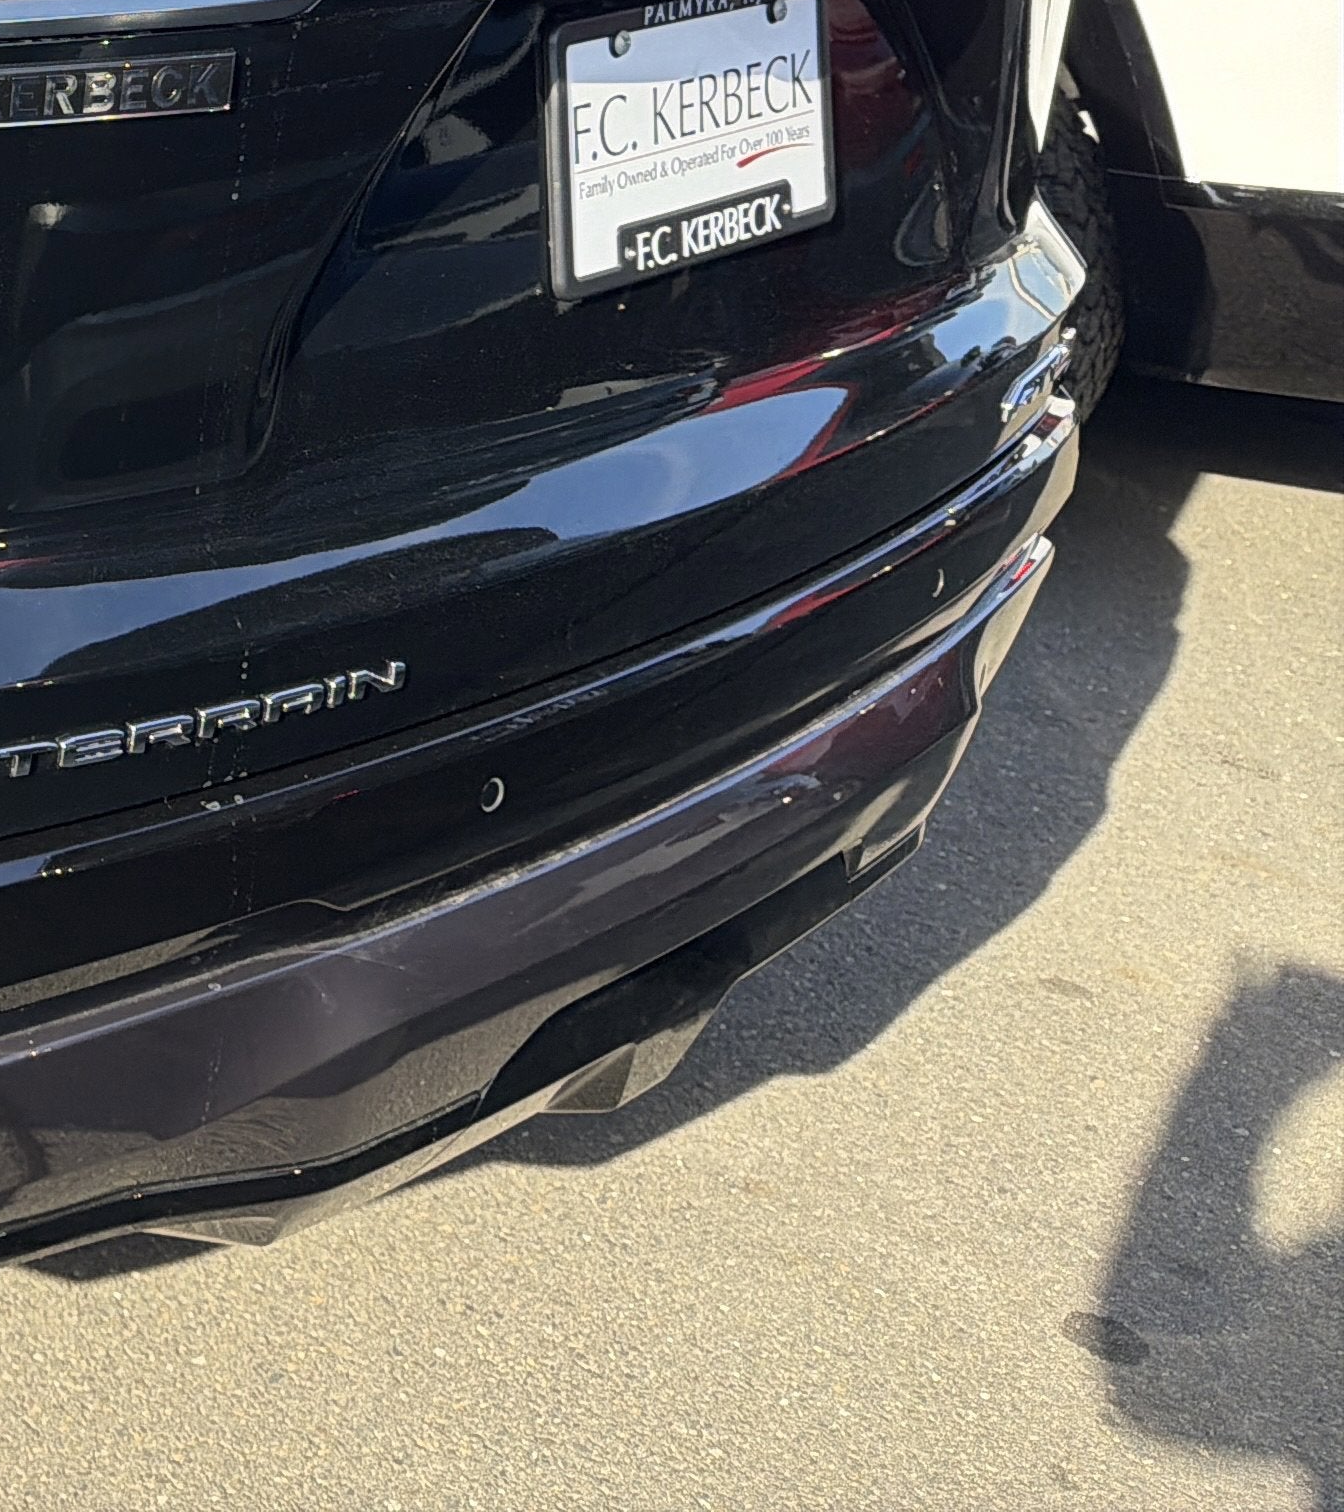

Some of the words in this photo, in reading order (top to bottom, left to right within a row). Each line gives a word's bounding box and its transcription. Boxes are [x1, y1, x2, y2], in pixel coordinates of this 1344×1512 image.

[574, 94, 638, 165] F.C.
[652, 48, 812, 145] KERBECK
[578, 175, 615, 200] Family
[616, 162, 658, 190] Owned
[661, 162, 669, 178] &
[670, 145, 720, 177] Operated
[720, 143, 737, 162] For
[738, 136, 763, 156] Over
[765, 129, 784, 148] 100
[784, 124, 810, 143] Years
[636, 225, 679, 271] F.C.
[681, 193, 783, 258] KERBECK
